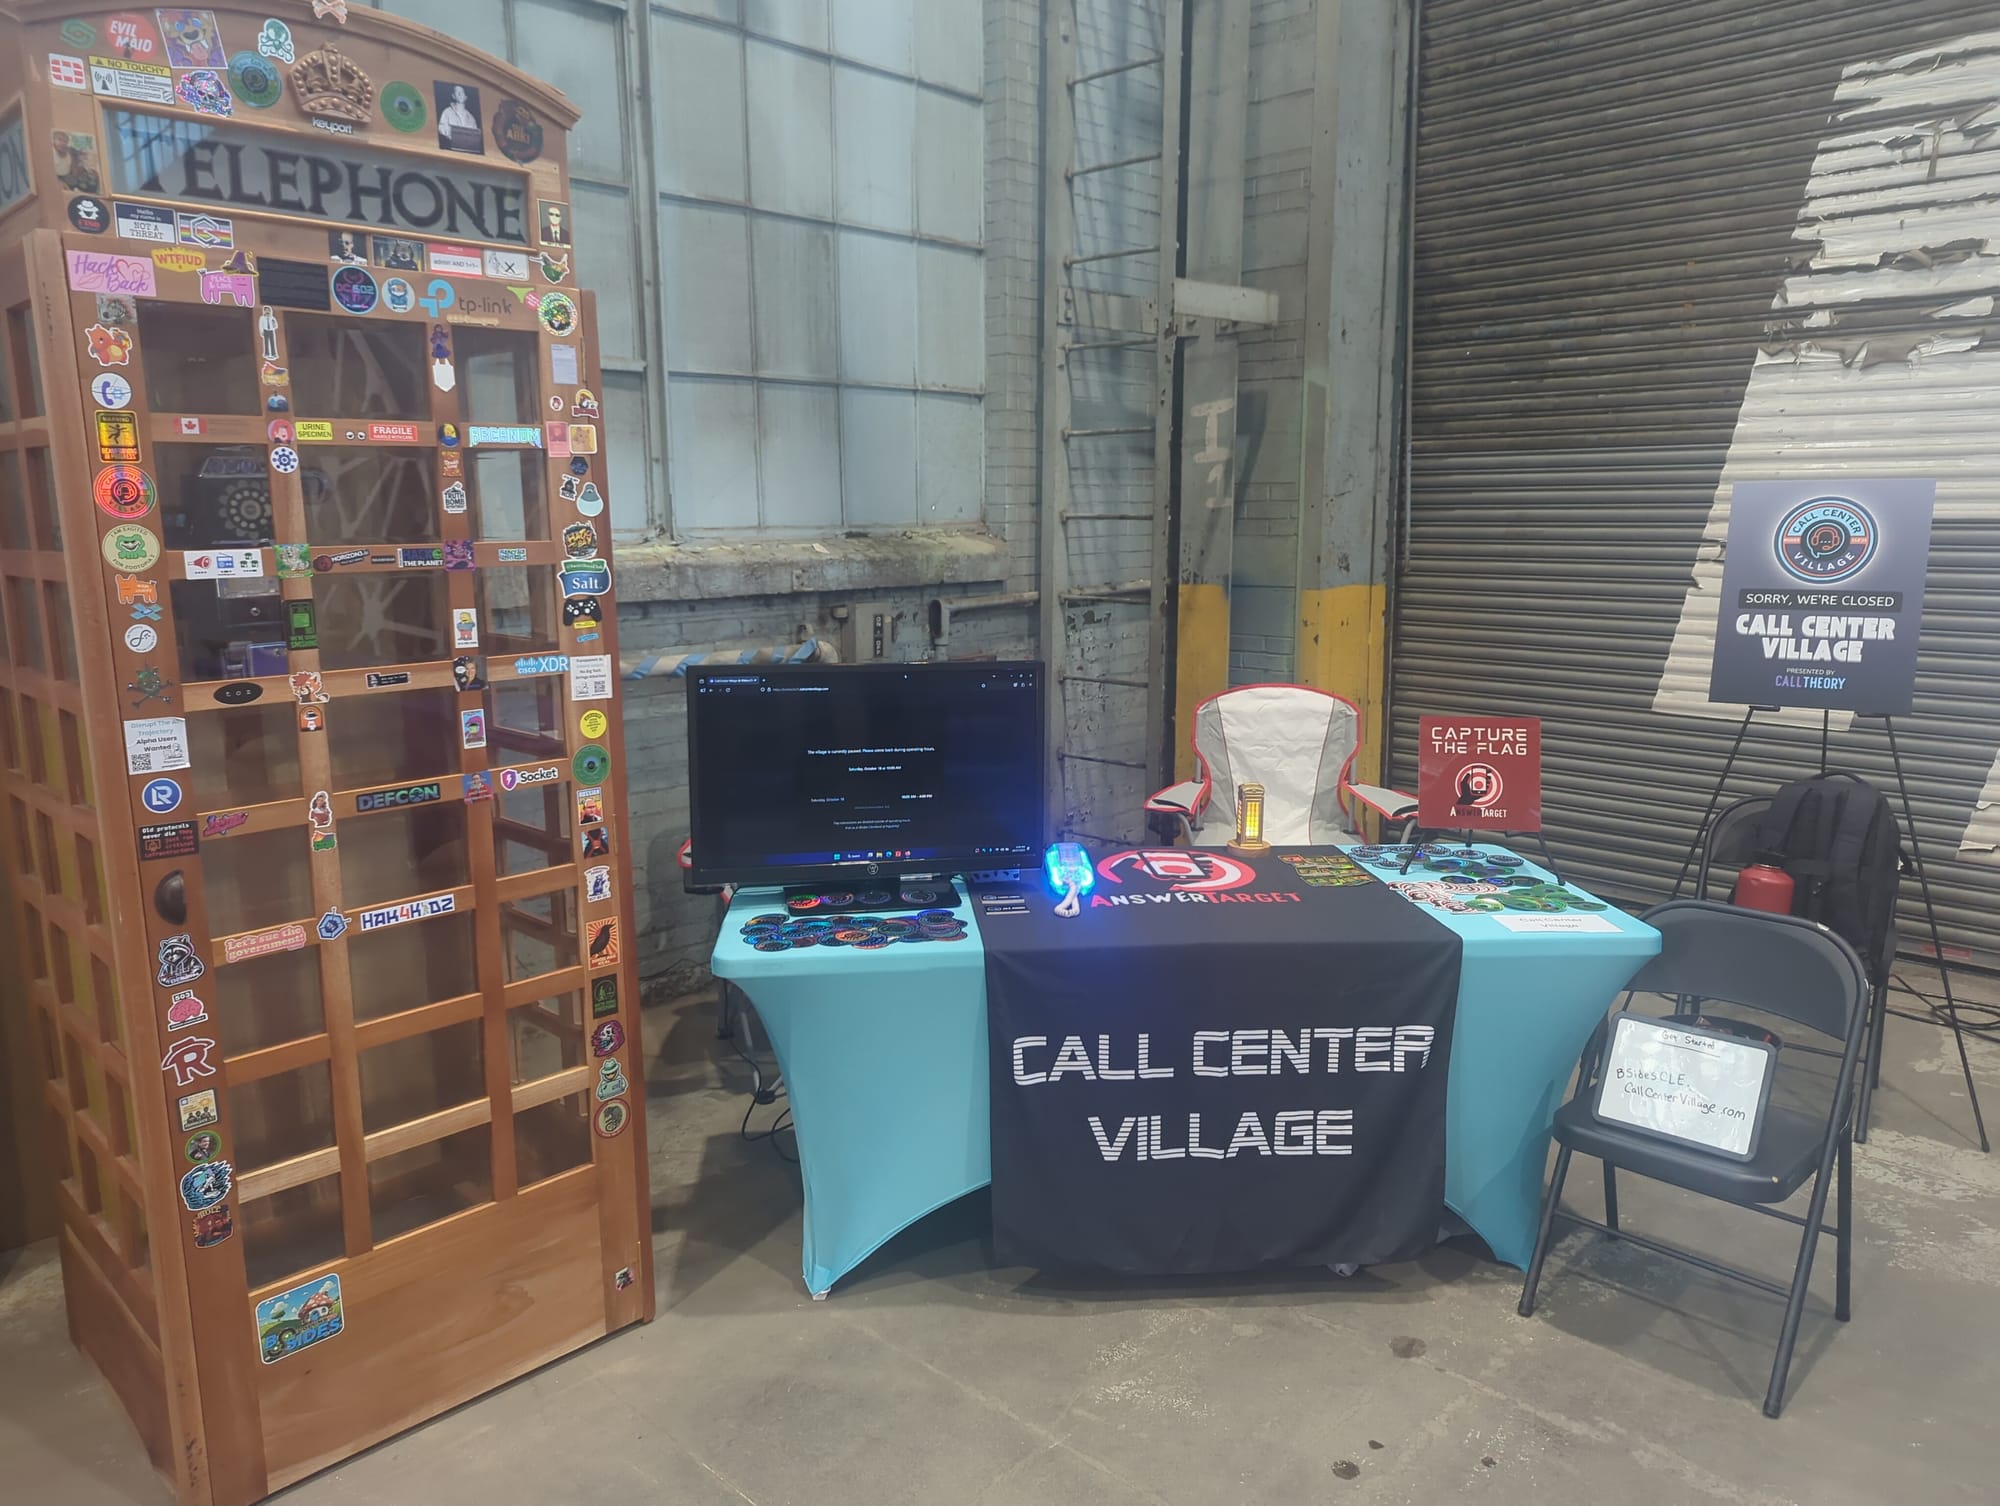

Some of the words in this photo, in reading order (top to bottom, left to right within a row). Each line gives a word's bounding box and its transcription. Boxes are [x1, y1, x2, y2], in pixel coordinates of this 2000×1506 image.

[110, 20, 138, 36] EVIL
[115, 35, 153, 53] MAID
[107, 59, 122, 68] NO
[126, 62, 165, 75] TOUCHY
[129, 229, 164, 240] THREAT
[134, 222, 151, 231] NOT
[75, 255, 118, 276] Hack
[107, 274, 149, 292] Back
[458, 296, 513, 318] tp-link
[297, 430, 333, 439] SPECIMEN
[302, 423, 326, 431] URINE
[373, 426, 413, 435] FRAGILE
[1792, 511, 1818, 534] CALL
[1822, 508, 1862, 534] CENTER
[1793, 551, 1855, 571] VILLAGE
[1746, 593, 1792, 606] SORRY,
[1797, 594, 1837, 606] WE'RE
[1841, 595, 1895, 607] CLOSED
[1735, 614, 1793, 636] CALL
[1801, 616, 1896, 640] CENTER
[1762, 637, 1864, 663] VILLAGE
[539, 656, 569, 672] XDR
[1786, 667, 1824, 675] PRESENTED
[1775, 675, 1846, 690] CALLTHEORY
[136, 737, 157, 745] Alpha
[158, 735, 177, 743] Users
[1431, 726, 1527, 742] CAPTURE
[144, 744, 172, 752] Wanted
[1431, 741, 1468, 754] THE
[1476, 742, 1527, 756] FLAG
[520, 769, 557, 783] Socket
[142, 826, 155, 834] Old
[156, 823, 190, 833] protocols
[258, 932, 280, 943] sue
[281, 926, 302, 938] the
[1662, 1030, 1678, 1042] Get
[1684, 1035, 1715, 1050] Started
[1012, 1033, 1174, 1086] CALL
[1192, 1025, 1435, 1078] CENTER
[1087, 1109, 1354, 1162] VILLAGE
